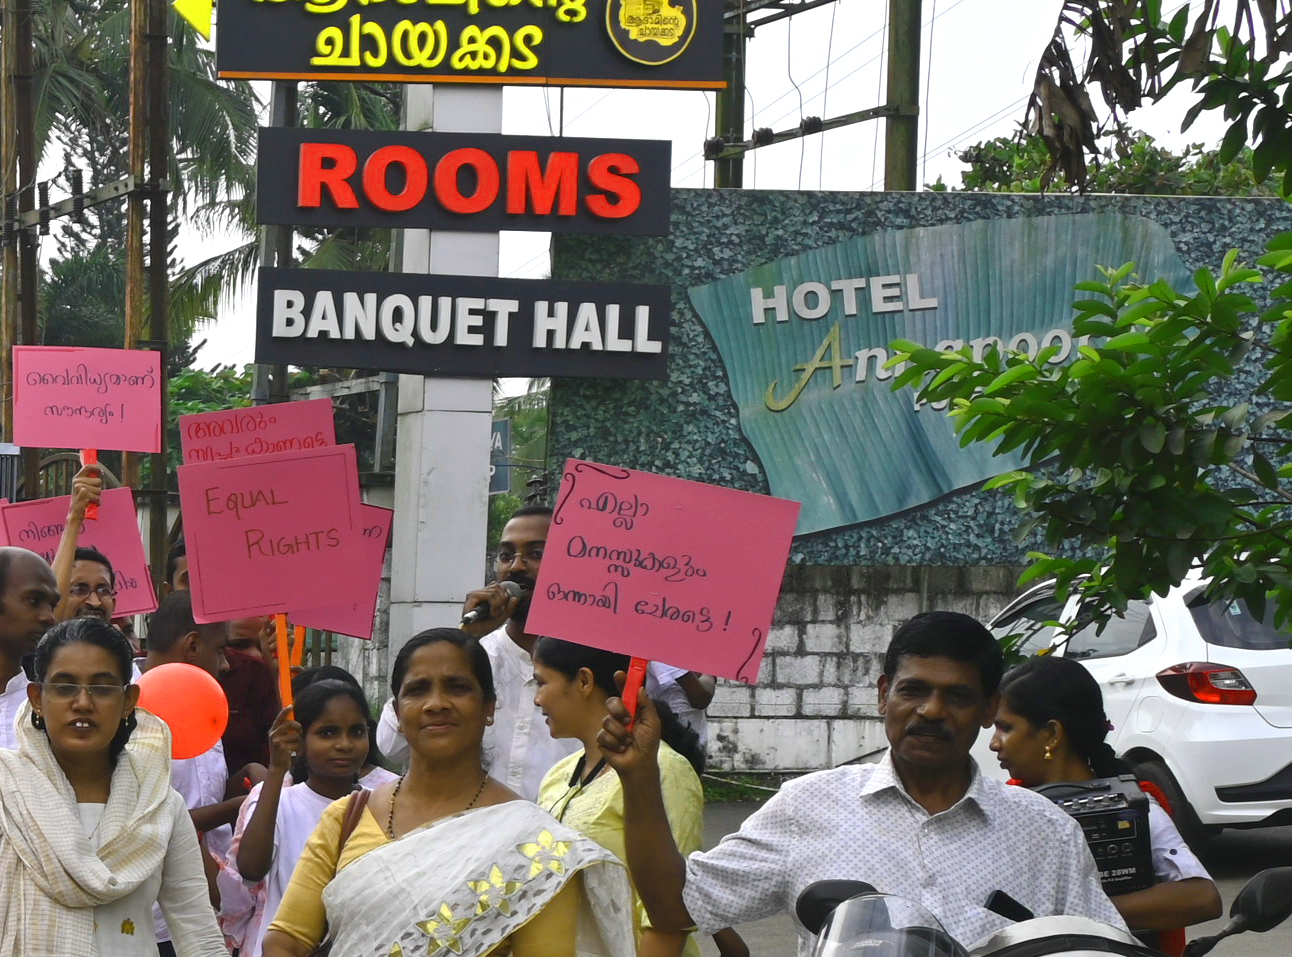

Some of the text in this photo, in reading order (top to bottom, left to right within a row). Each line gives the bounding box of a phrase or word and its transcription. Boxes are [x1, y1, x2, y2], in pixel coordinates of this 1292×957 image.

[309, 13, 544, 73] ചായക്കട
[297, 141, 643, 219] ROOMS
[271, 288, 662, 354] BANQUET HALL
[750, 273, 938, 325] HOTEL
[187, 412, 277, 442] അവരും
[579, 491, 650, 531] എല്ലാ
[547, 581, 618, 614] ഒന്നായി
